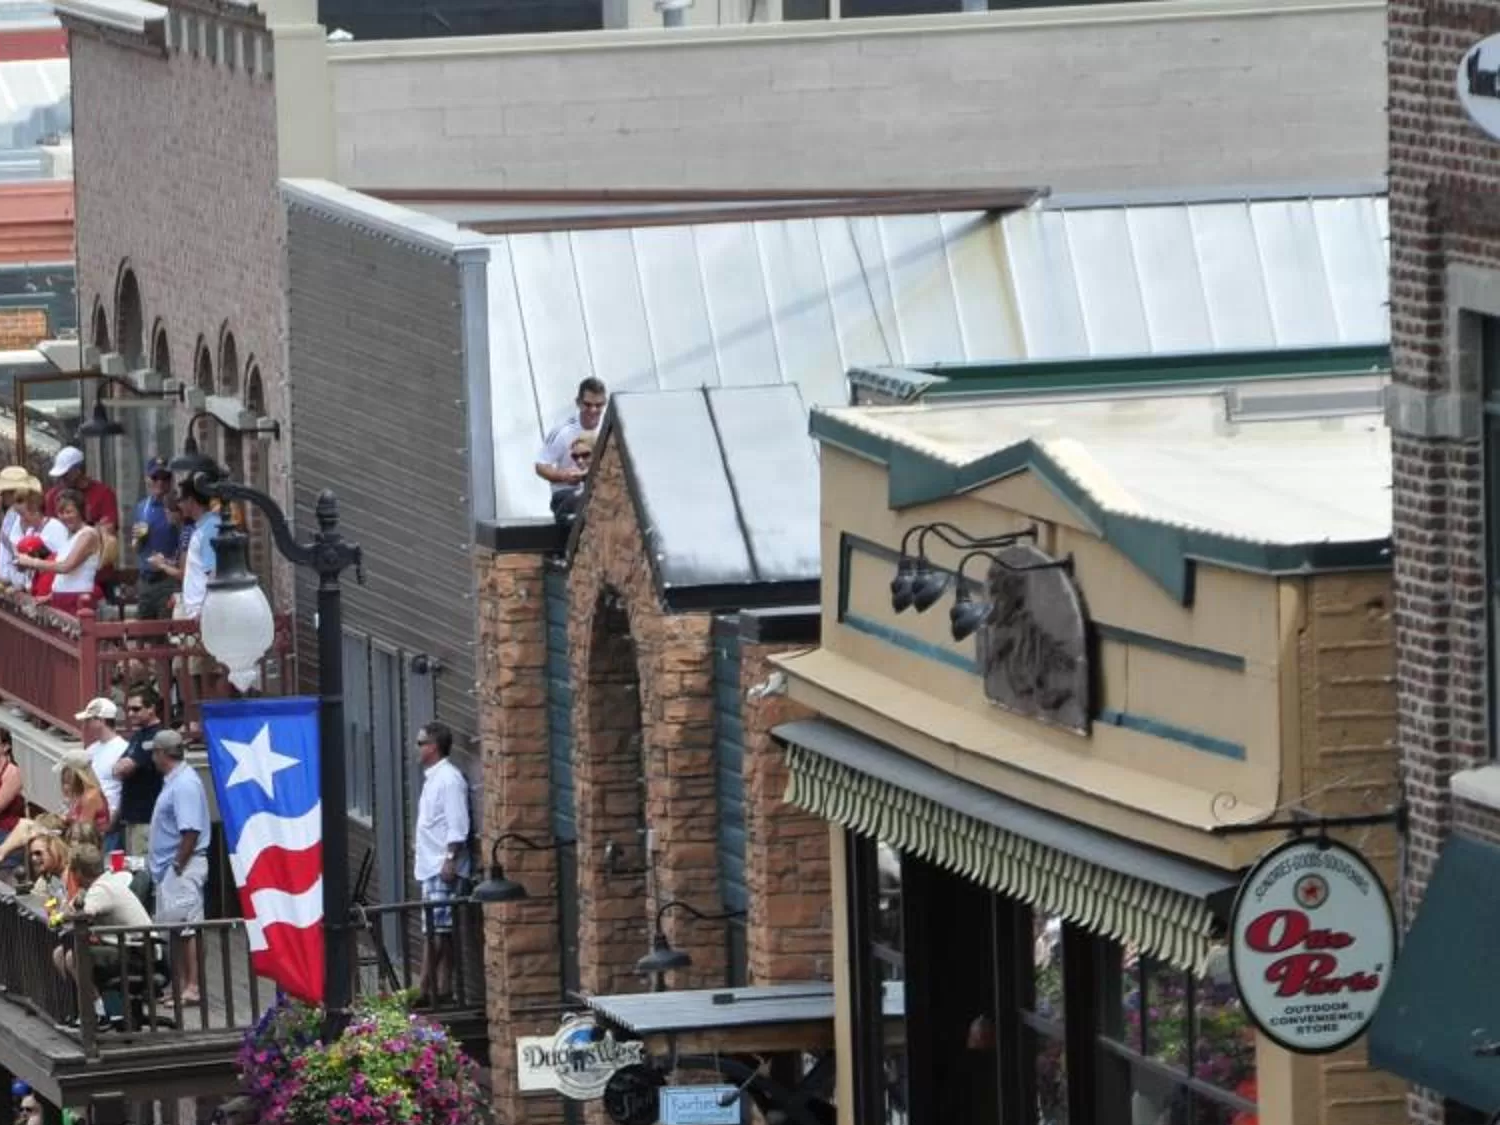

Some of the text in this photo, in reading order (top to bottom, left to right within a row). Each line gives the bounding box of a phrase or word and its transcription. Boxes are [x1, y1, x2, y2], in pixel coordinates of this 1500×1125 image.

[1283, 1001, 1350, 1016] OUTDOOR
[1269, 1010, 1365, 1026] CONVENIENCE
[1295, 1023, 1339, 1036] STORE
